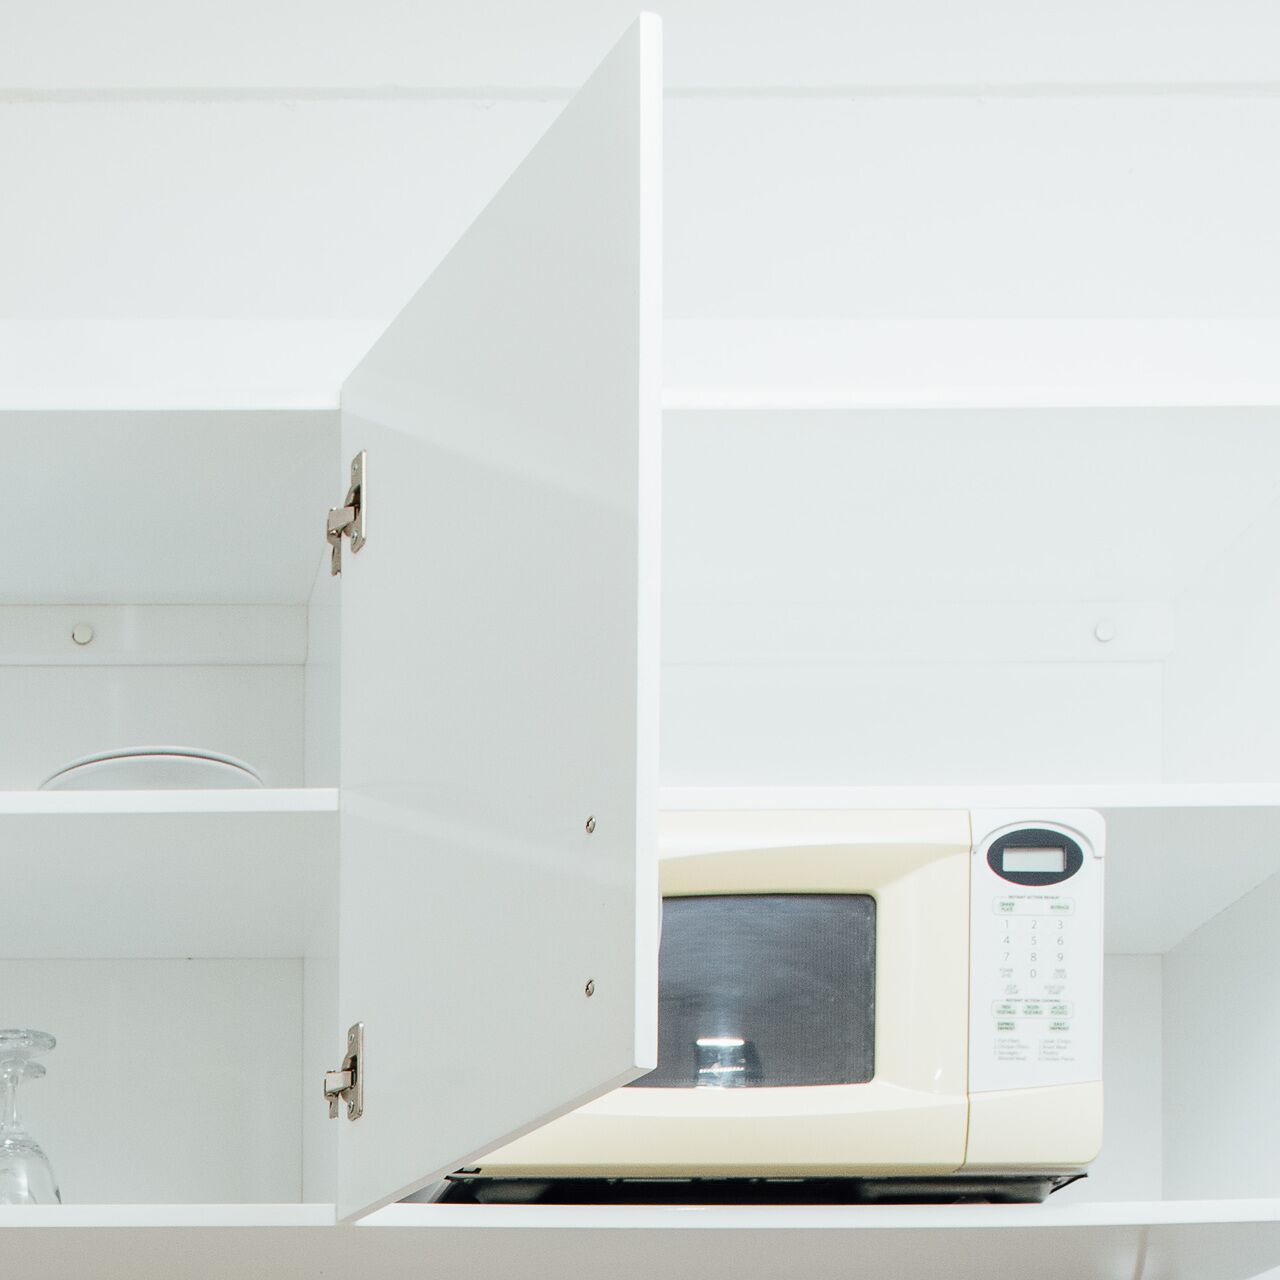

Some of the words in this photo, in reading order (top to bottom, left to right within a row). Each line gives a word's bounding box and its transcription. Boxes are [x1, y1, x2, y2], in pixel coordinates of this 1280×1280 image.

[1003, 920, 1008, 929] 1
[1031, 920, 1038, 929] 2
[1057, 920, 1064, 930] 3
[1002, 936, 1010, 944] 4
[1031, 936, 1038, 946] 5
[1056, 936, 1064, 946] 6
[1003, 952, 1010, 961] 7
[1030, 952, 1038, 962] 8
[1057, 952, 1064, 962] 9
[1030, 968, 1038, 978] 0
